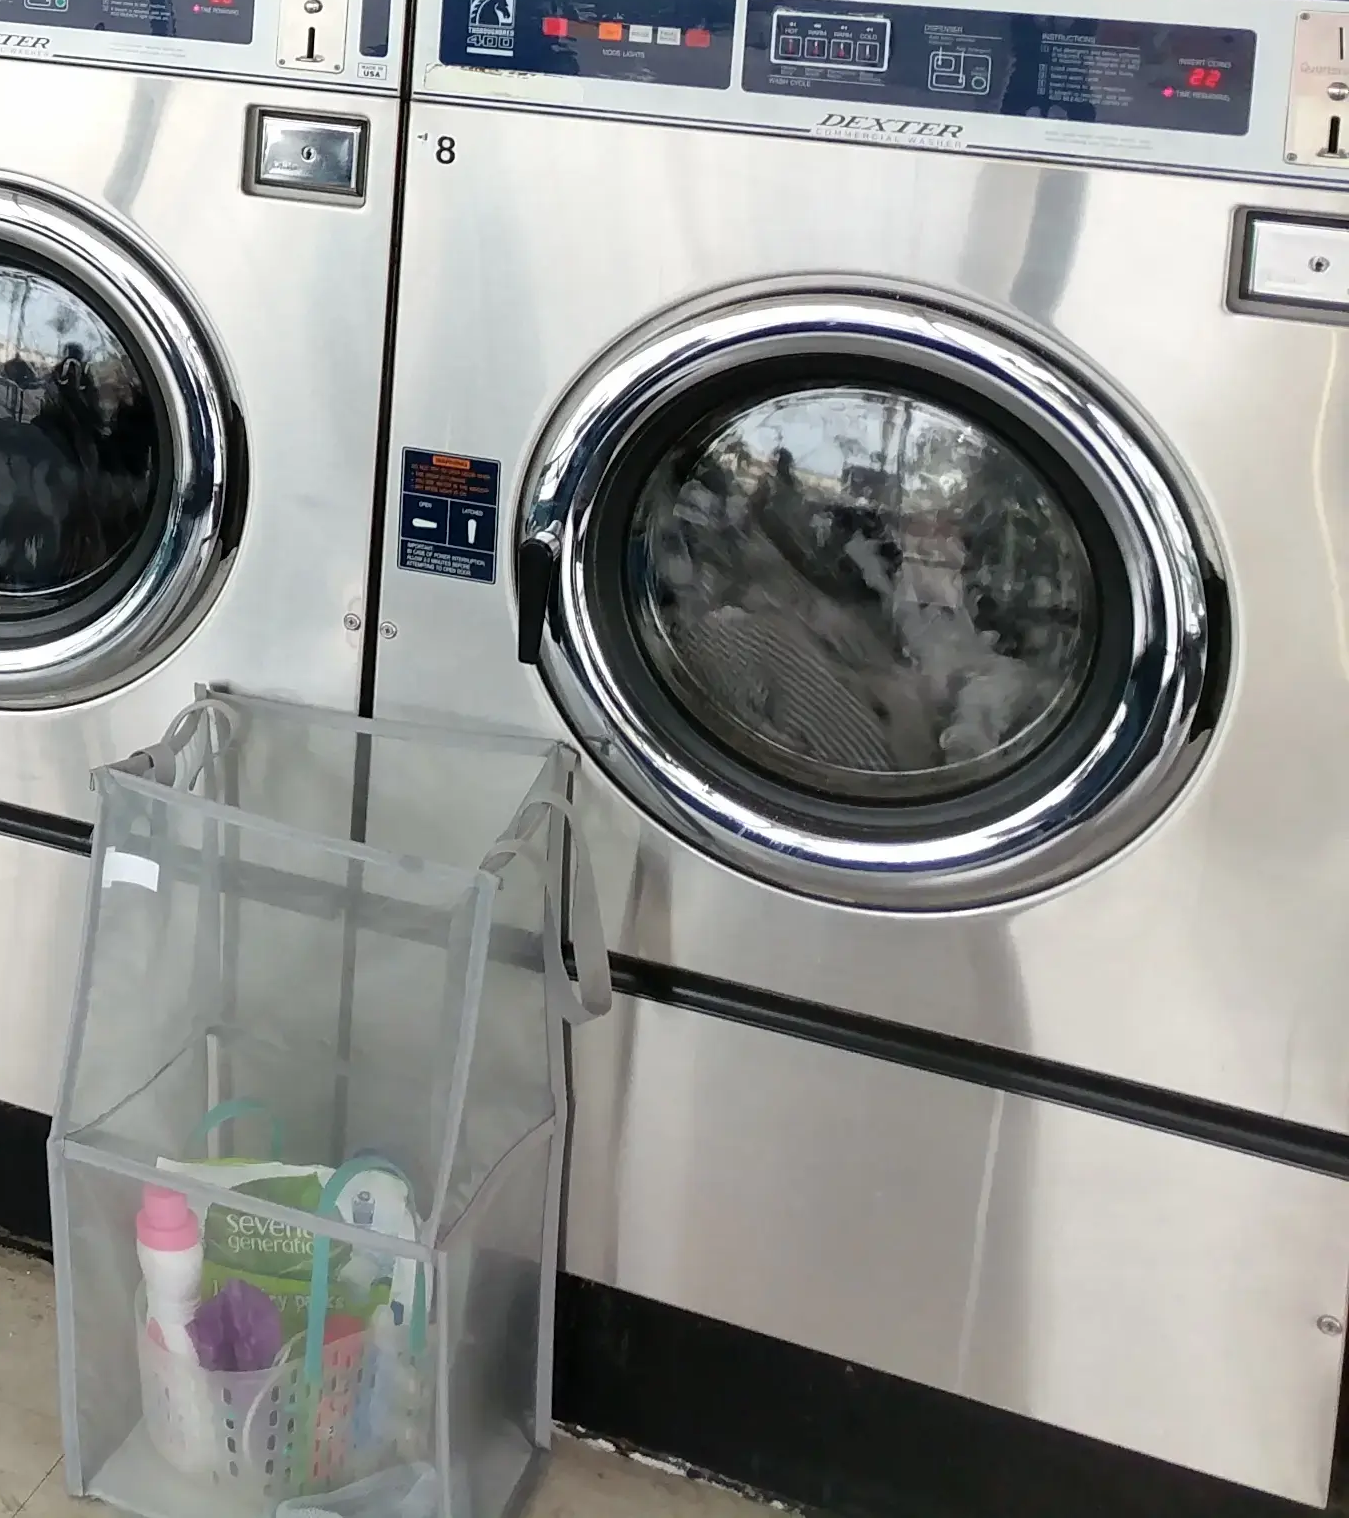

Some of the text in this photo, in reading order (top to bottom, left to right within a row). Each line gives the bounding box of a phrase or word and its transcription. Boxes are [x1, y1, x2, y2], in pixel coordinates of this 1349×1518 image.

[466, 35, 515, 49] 400
[363, 70, 381, 78] USA
[1188, 68, 1221, 88] 22
[815, 127, 900, 144] COMMERCIAL
[816, 113, 966, 139] DEXTER
[226, 1213, 314, 1239] seven
[227, 1235, 315, 1255] generatio
